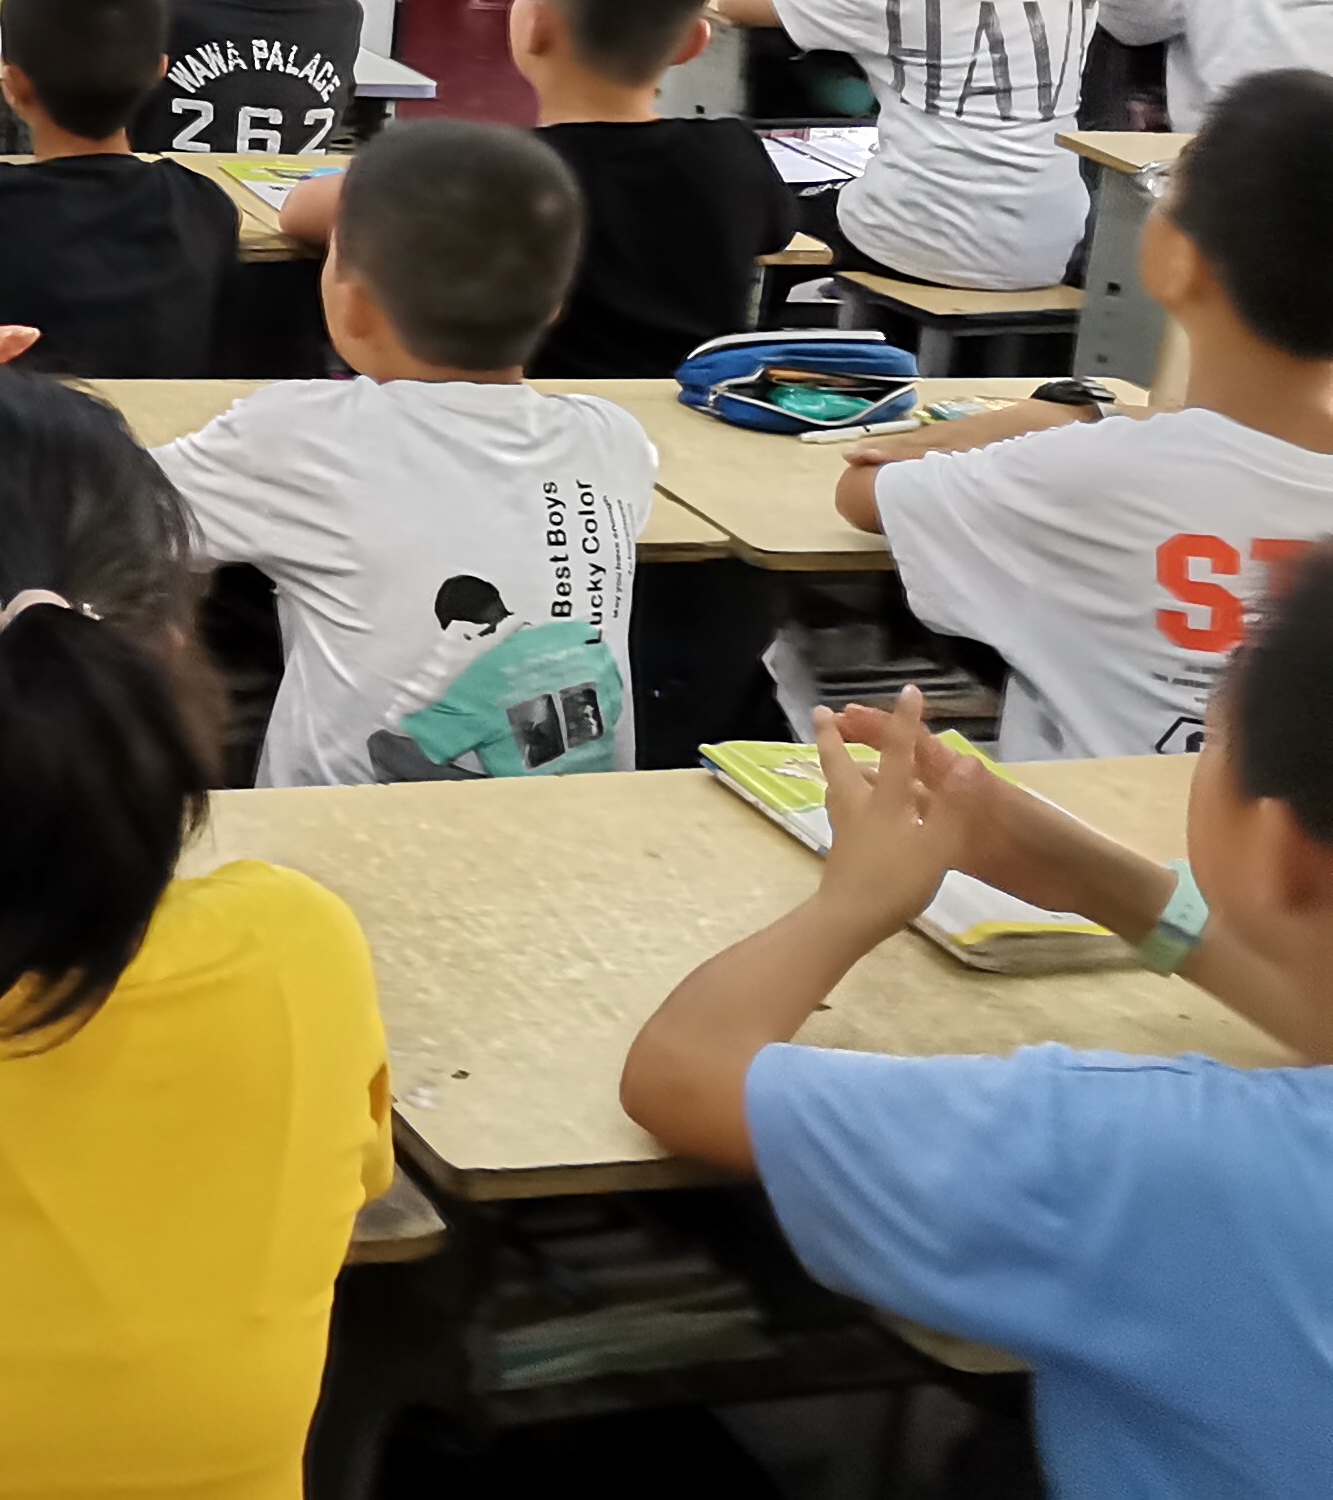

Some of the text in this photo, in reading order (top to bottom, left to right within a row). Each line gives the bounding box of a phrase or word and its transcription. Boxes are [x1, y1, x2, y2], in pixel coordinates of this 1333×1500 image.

[167, 39, 341, 102] WAWA PALACE
[171, 98, 336, 155] 262
[542, 481, 573, 618] Best Boys
[575, 479, 608, 645] Lucky Color
